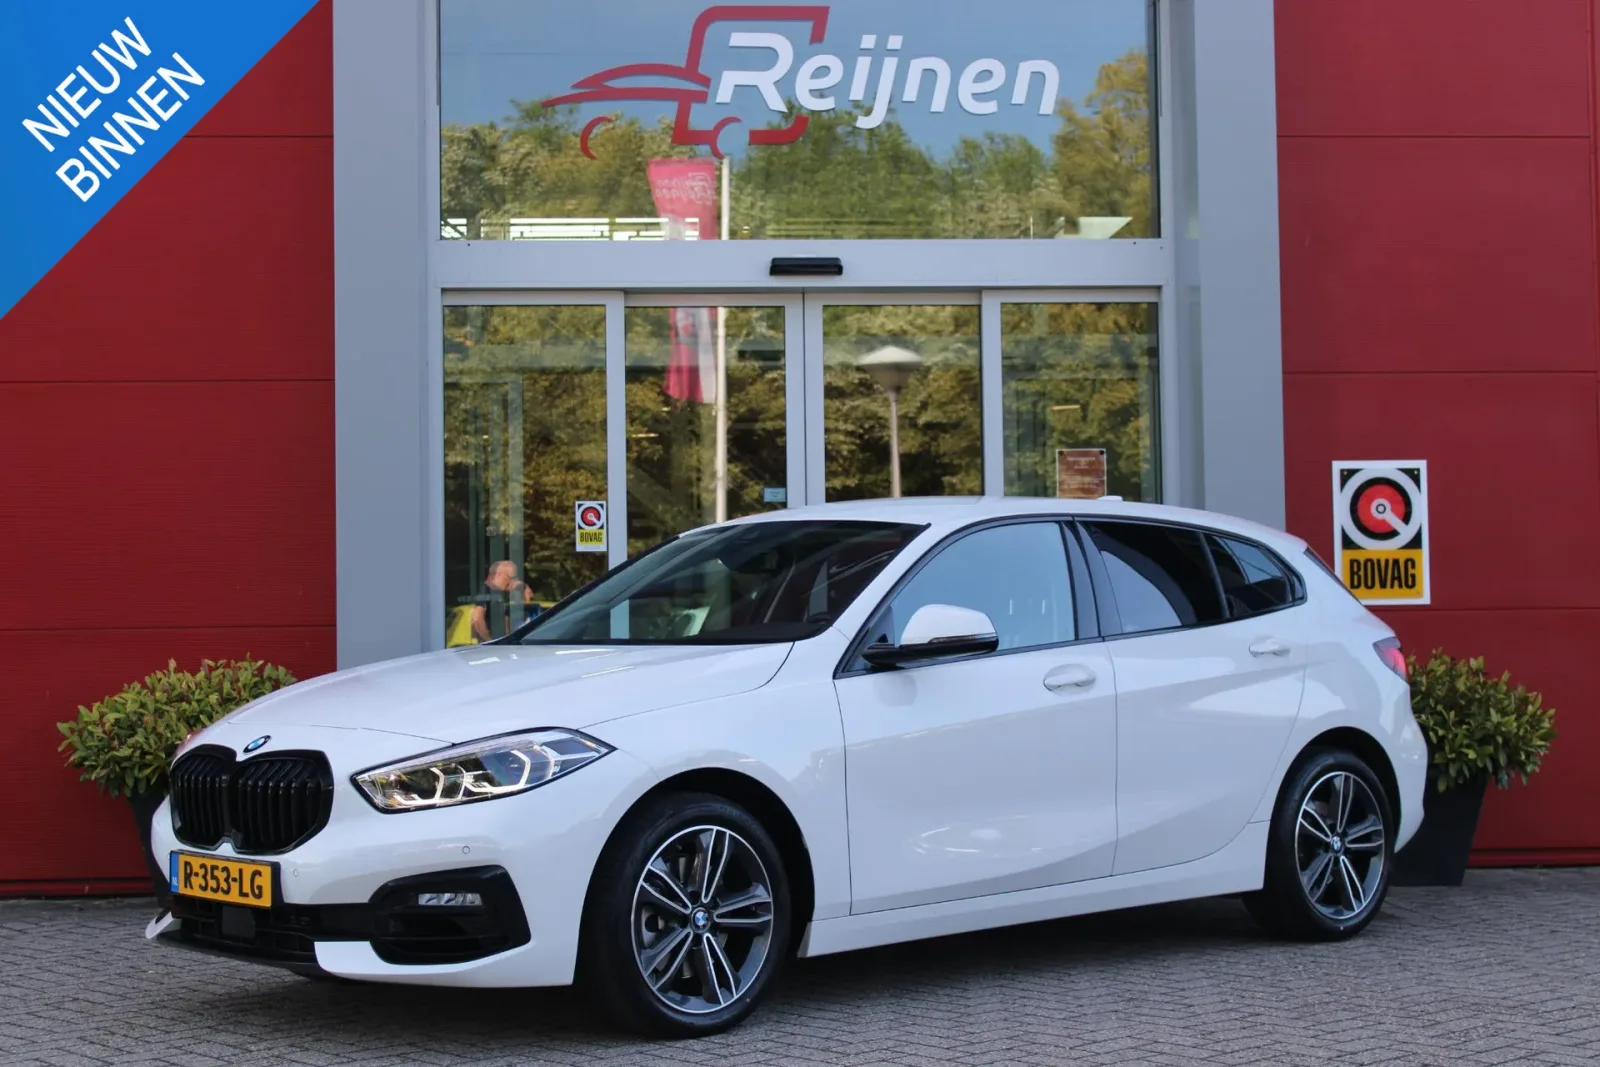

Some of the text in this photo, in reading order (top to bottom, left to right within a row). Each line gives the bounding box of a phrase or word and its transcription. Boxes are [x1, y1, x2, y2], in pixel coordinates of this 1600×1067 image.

[715, 31, 1060, 130] Reijnen
[579, 531, 603, 543] BOVAG
[1349, 557, 1417, 590] BOVAG
[183, 860, 263, 900] R-353-LG
